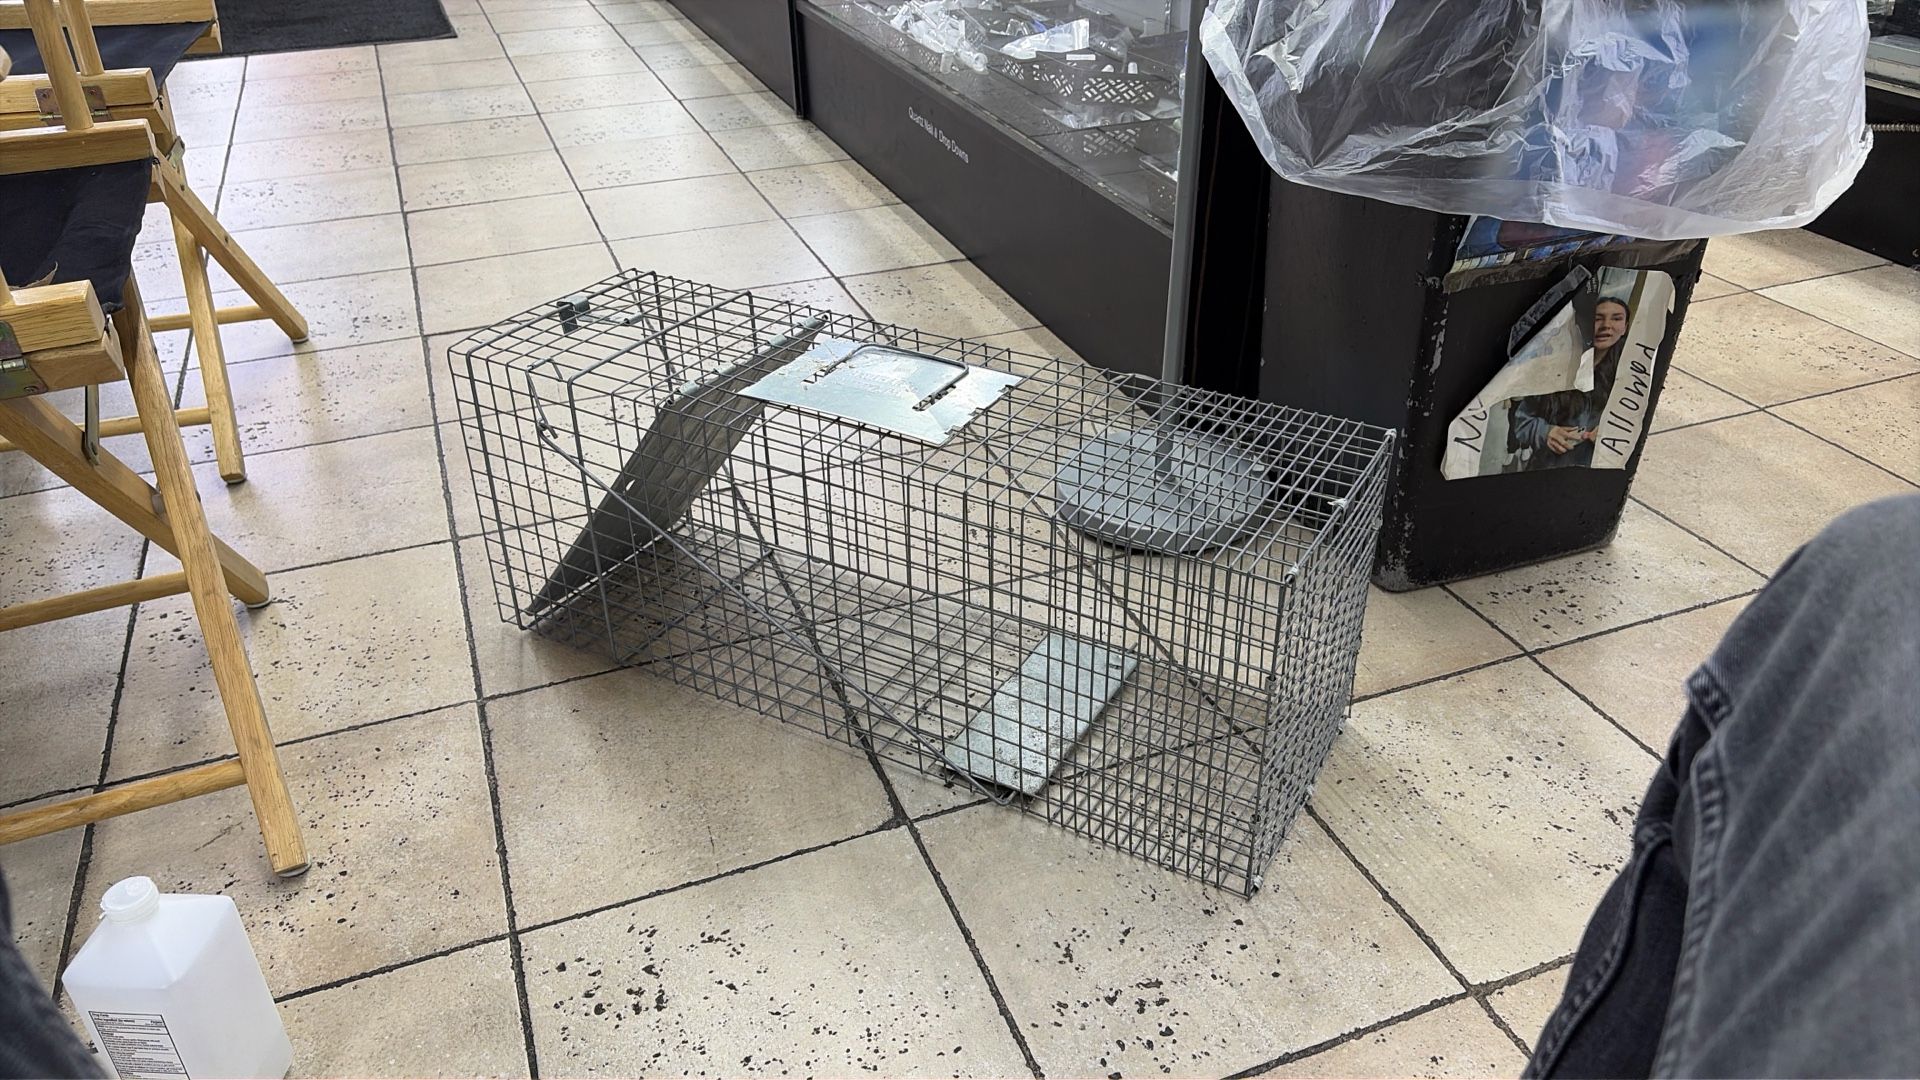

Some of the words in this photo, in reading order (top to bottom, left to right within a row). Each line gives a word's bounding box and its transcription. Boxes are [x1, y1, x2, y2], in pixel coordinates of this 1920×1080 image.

[908, 106, 924, 127] Quartz
[939, 130, 951, 151] Drop
[1600, 343, 1655, 456] Allowed
